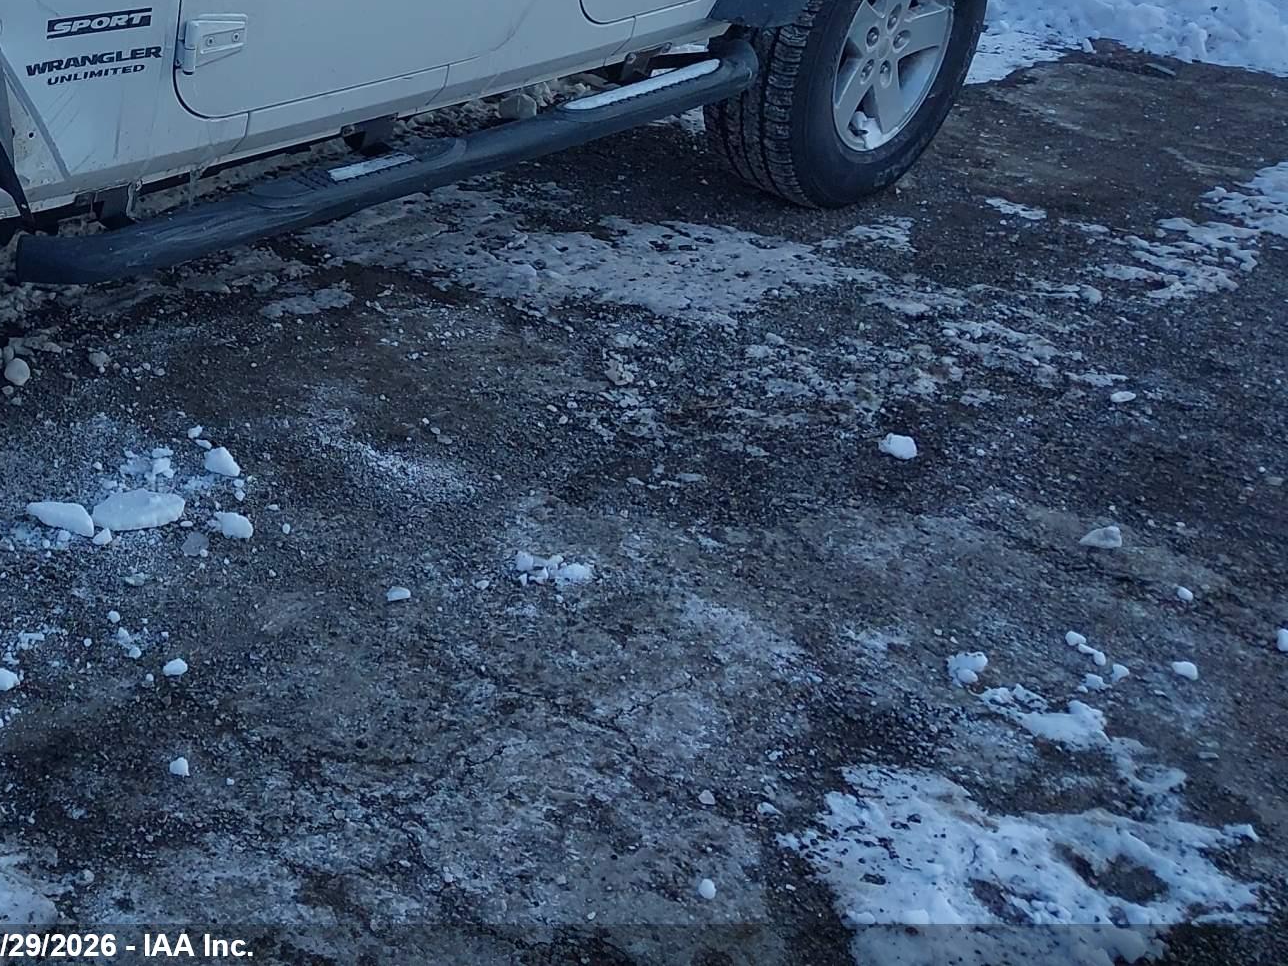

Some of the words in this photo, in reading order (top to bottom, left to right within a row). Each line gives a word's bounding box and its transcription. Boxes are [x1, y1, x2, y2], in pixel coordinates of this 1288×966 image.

[53, 13, 151, 34] SPORT
[25, 46, 163, 76] WRANGLER
[47, 64, 146, 86] UNLIMITED
